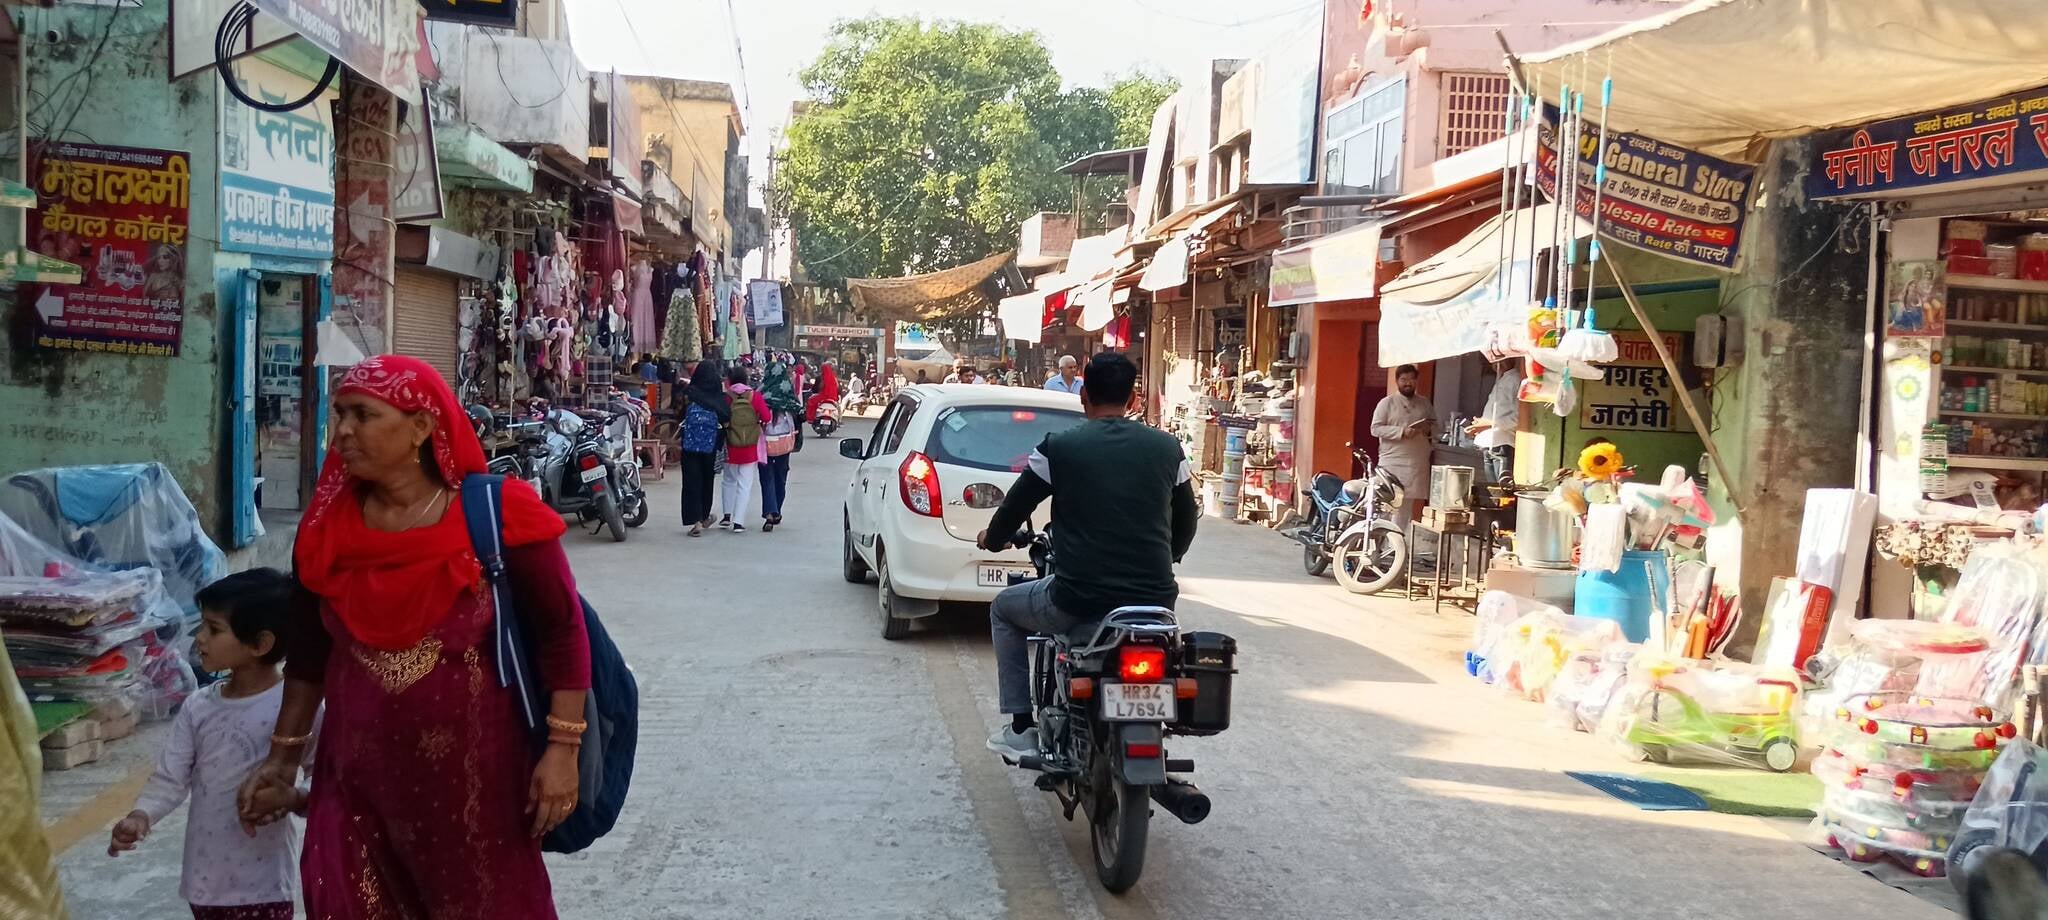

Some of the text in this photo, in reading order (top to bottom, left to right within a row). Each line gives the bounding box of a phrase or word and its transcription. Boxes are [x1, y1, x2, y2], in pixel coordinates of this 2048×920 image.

[1914, 115, 1941, 134] सबसे
[1943, 112, 1973, 129] सस्ता
[1986, 99, 2017, 120] सबसे
[1628, 135, 1657, 153] सबसे
[1657, 148, 1686, 162] अच्छा
[1823, 129, 1897, 189] मनीष
[1906, 118, 2019, 177] जनरल
[42, 155, 190, 209] महालक्ष्मी
[1604, 142, 1688, 188] General
[1693, 165, 1745, 202] Store
[1619, 180, 1640, 200] Shop
[1640, 186, 1650, 201] से
[1650, 188, 1660, 204] भी
[42, 203, 188, 246] बैंगल कॉर्नर
[224, 186, 274, 227] प्रकाश
[274, 187, 305, 231] बीज
[1614, 225, 1642, 244] सस्ते
[1644, 235, 1673, 249] Rate
[1673, 239, 1690, 256] की
[1693, 246, 1730, 263] गारन्टी
[1660, 217, 1702, 237] Rate
[1705, 229, 1729, 241] पर
[1590, 398, 1671, 427] जलेबी
[987, 569, 1003, 583] HR
[1122, 685, 1161, 699] HR34
[1116, 703, 1166, 717] L7694
